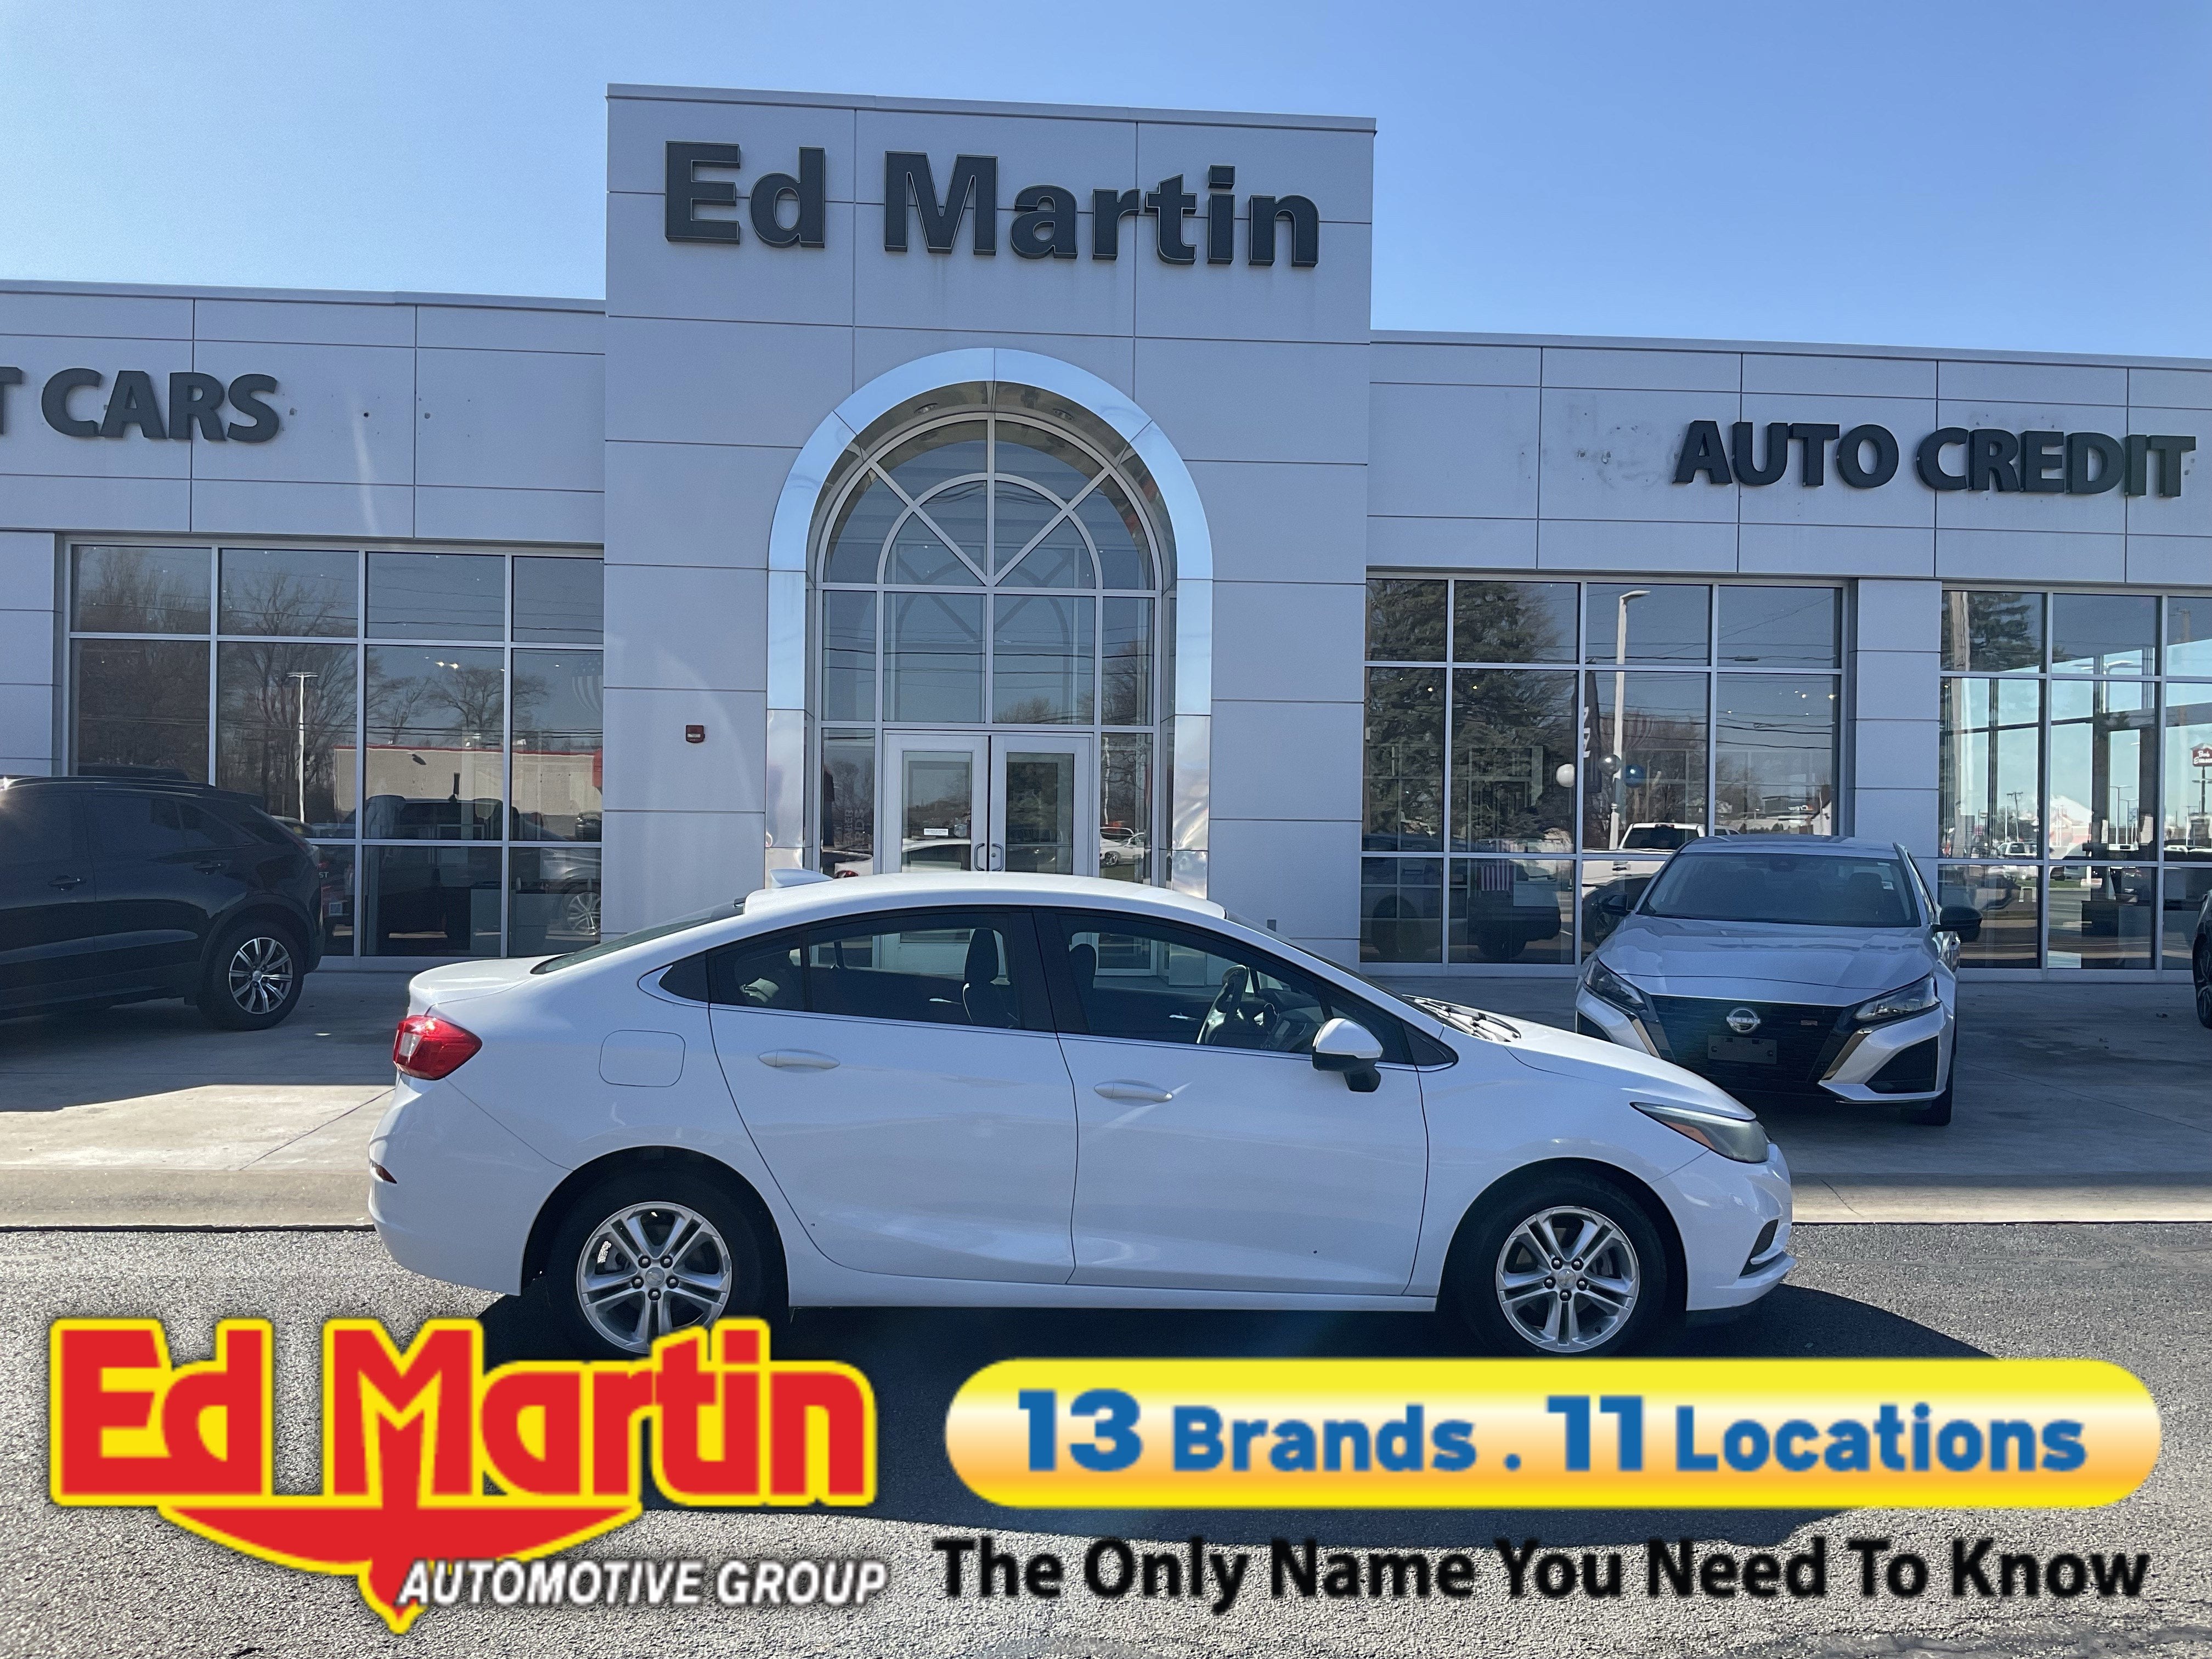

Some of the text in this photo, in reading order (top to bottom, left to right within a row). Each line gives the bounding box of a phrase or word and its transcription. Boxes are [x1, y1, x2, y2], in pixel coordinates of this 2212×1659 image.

[664, 140, 1319, 268] Ed Martin
[41, 367, 280, 443] CARS
[1672, 420, 2197, 498] AUTO CREDIT
[1726, 1016, 1761, 1024] NISSAN
